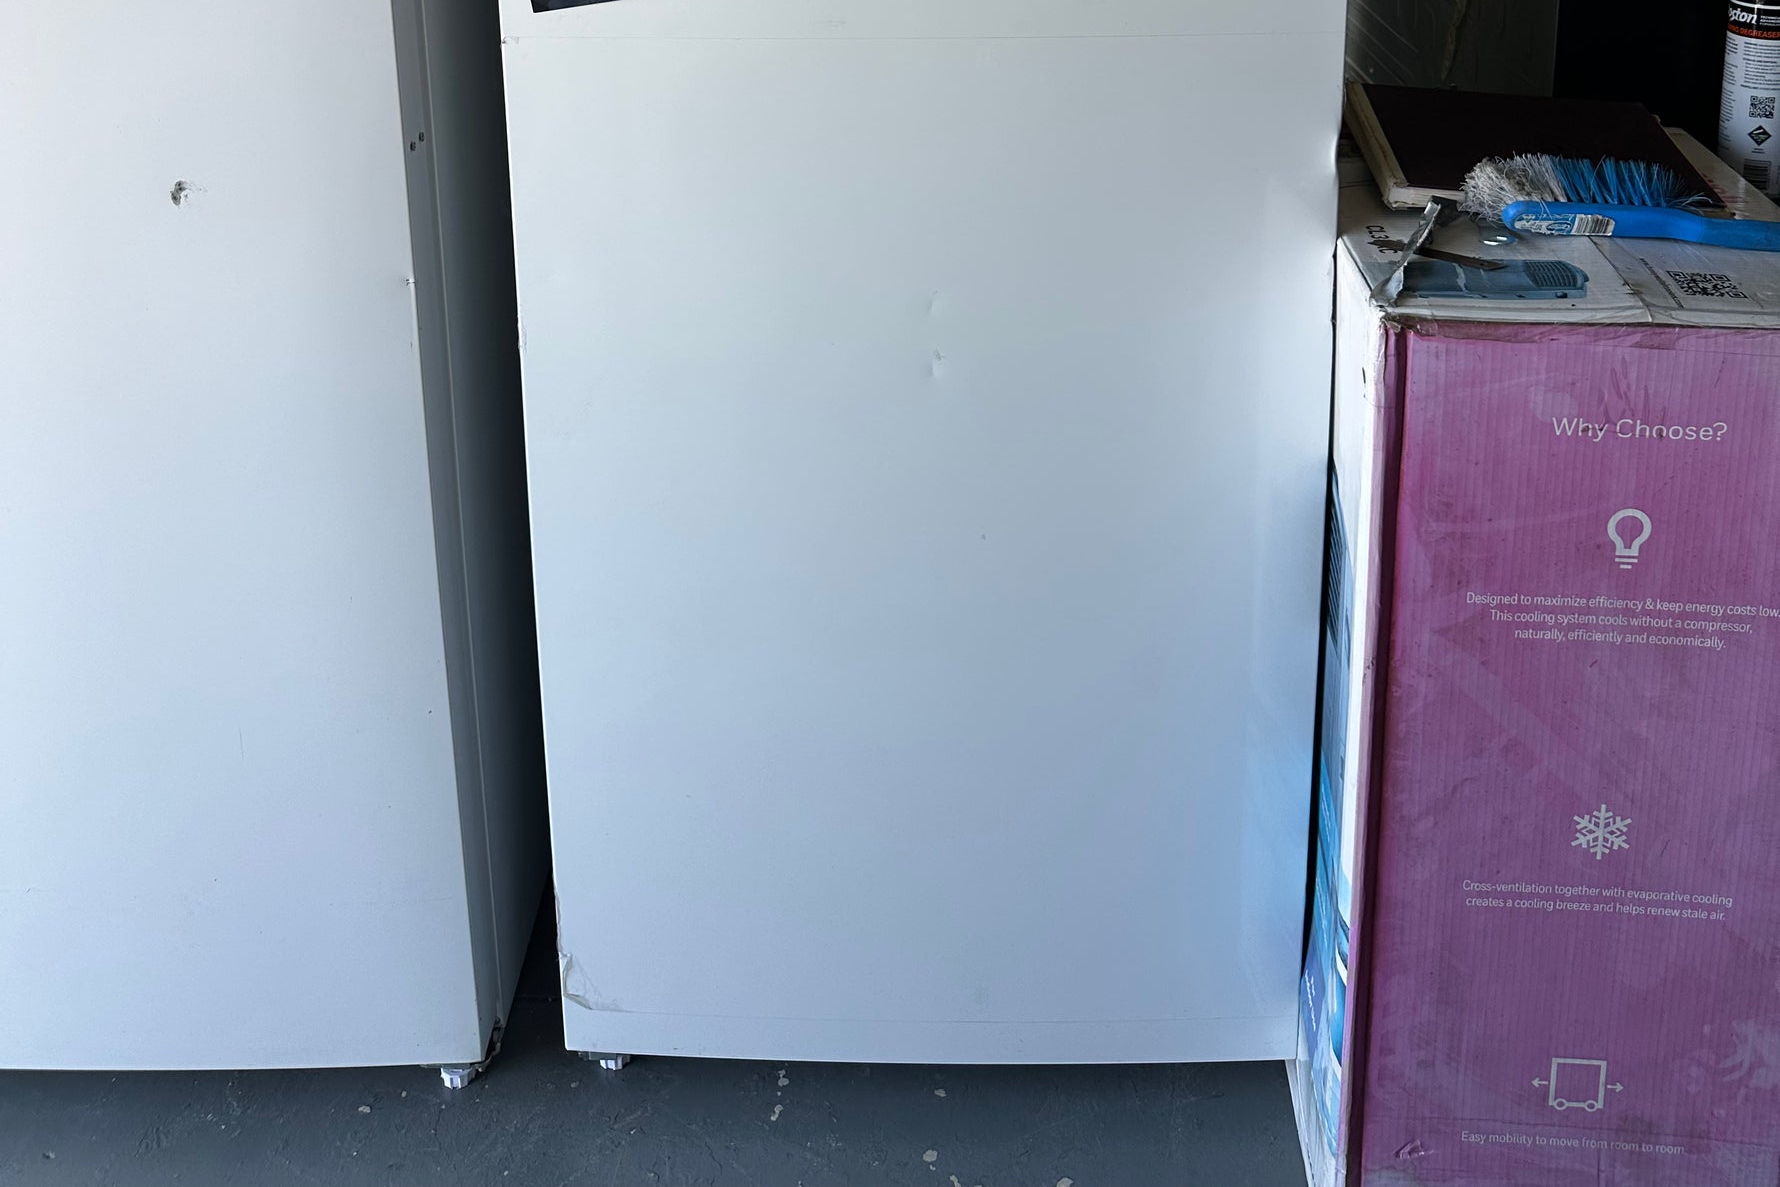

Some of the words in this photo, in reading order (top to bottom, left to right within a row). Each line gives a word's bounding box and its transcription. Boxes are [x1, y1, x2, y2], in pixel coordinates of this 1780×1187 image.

[1552, 416, 1609, 443] Why
[1616, 418, 1728, 441] Choose?
[1466, 591, 1518, 606] Designed
[1520, 594, 1531, 605] to
[1533, 594, 1587, 607] maximize
[1588, 595, 1643, 612] efficiency
[1645, 598, 1654, 610] &
[1656, 599, 1683, 613] keep
[1685, 602, 1725, 616] energy
[1727, 605, 1757, 616] costs
[1759, 605, 1780, 617] low.
[1490, 609, 1513, 621] This
[1514, 611, 1555, 625] cooling
[1557, 613, 1596, 626] system
[1599, 614, 1628, 625] cools
[1629, 615, 1672, 628] without
[1674, 620, 1682, 628] a
[1684, 619, 1753, 634] compressor,
[1514, 628, 1566, 642] naturally,
[1568, 629, 1623, 645] efficiently
[1625, 632, 1646, 644] and
[1649, 635, 1726, 651] economically.
[1462, 879, 1552, 894] Cross-ventilation
[1555, 883, 1600, 897] together
[1602, 887, 1625, 897] with
[1627, 890, 1690, 903] evaporative
[1692, 894, 1733, 908] cooling
[1466, 897, 1504, 907] creates
[1506, 899, 1513, 907] a
[1515, 898, 1554, 911] cooling
[1556, 899, 1591, 911] breeze
[1593, 902, 1613, 912] and
[1616, 902, 1645, 915] helps
[1647, 907, 1680, 917] renew
[1681, 907, 1708, 919] stale
[1710, 910, 1726, 920] air.
[1461, 1131, 1486, 1144] Easy
[1488, 1132, 1533, 1148] mobility
[1535, 1135, 1547, 1145] to
[1549, 1137, 1579, 1147] move
[1582, 1138, 1608, 1149] from
[1610, 1141, 1639, 1151] room
[1641, 1142, 1653, 1152] to
